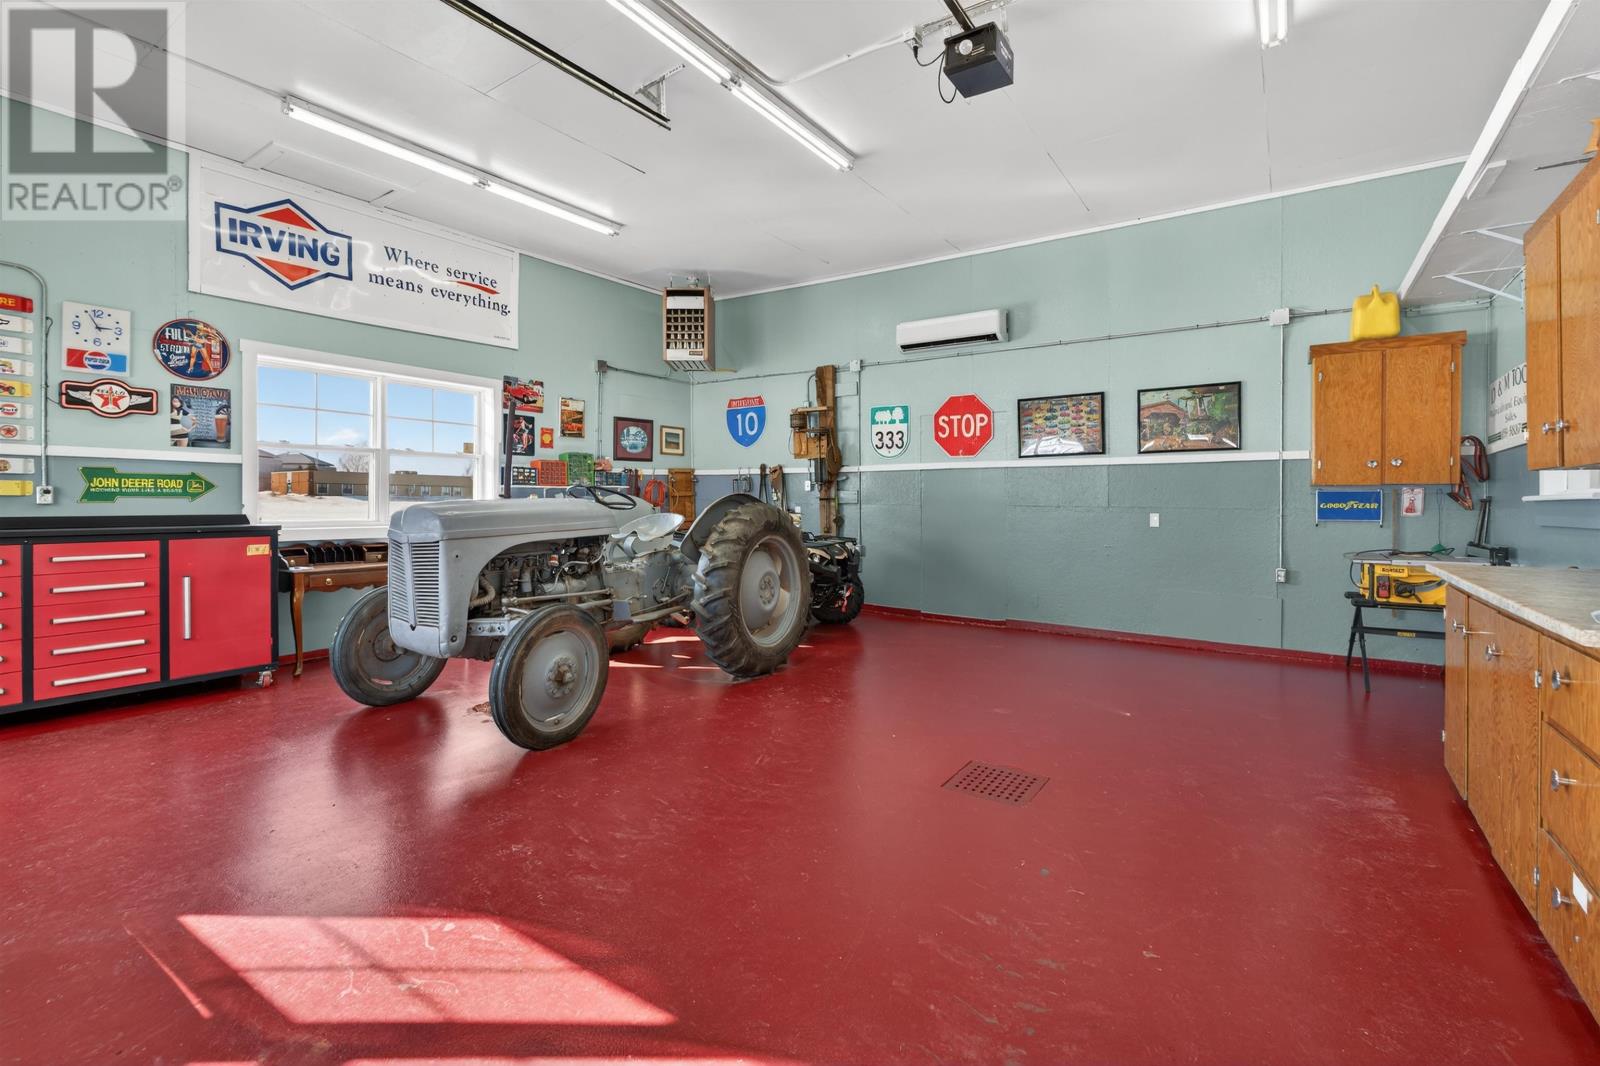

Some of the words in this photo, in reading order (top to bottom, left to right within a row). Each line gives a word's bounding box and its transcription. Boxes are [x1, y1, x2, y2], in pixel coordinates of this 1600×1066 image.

[227, 217, 342, 268] IRVING
[383, 244, 440, 275] Where
[445, 266, 499, 290] service
[367, 271, 424, 295] means
[430, 286, 512, 317] everything.
[91, 309, 104, 319] 12
[71, 320, 81, 330] 9
[113, 327, 123, 336] 3
[93, 337, 102, 347] 6
[736, 411, 759, 437] 10
[937, 413, 989, 439] STOP
[874, 429, 906, 451] 333
[90, 477, 119, 488] JOHN
[121, 478, 155, 489] DEERE
[157, 479, 184, 489] ROAD
[1319, 500, 1379, 511] GOODYEAR
